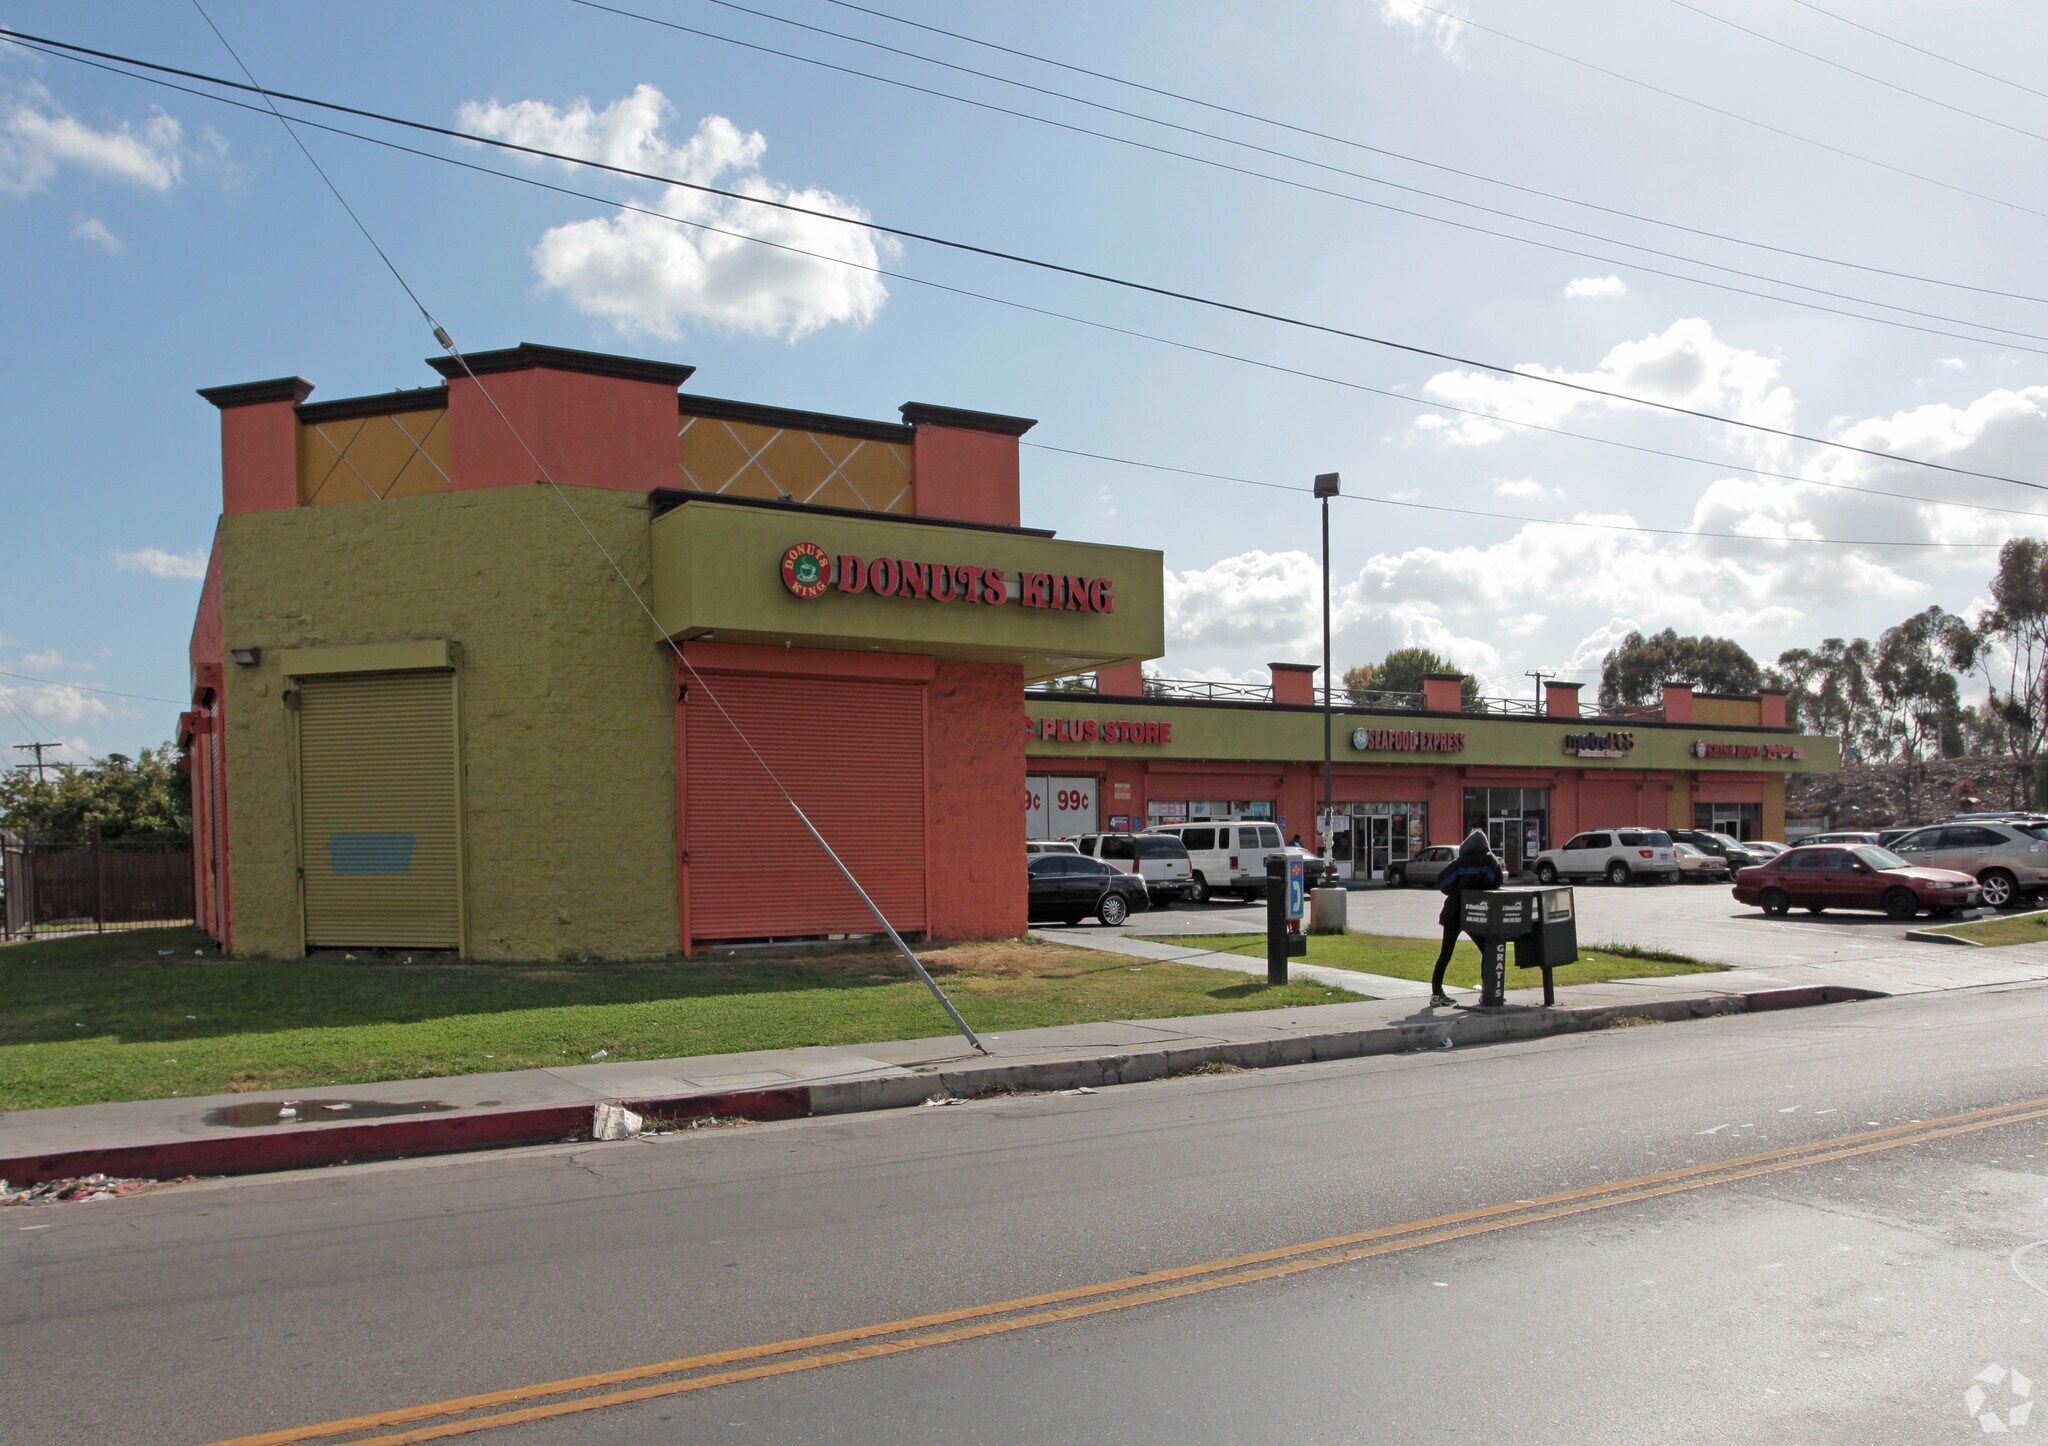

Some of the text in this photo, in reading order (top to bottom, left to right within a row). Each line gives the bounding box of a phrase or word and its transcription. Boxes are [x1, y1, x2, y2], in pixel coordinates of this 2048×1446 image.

[784, 543, 829, 570] DONUTS
[792, 581, 826, 597] KING
[837, 554, 1115, 614] DONUTS KING
[1041, 717, 1099, 743] PLUS
[1103, 720, 1172, 744] STORE
[1368, 729, 1465, 751] SEAFOOD EXPRESS
[1057, 789, 1090, 811] 99¢
[1495, 944, 1505, 997] GRATIS
